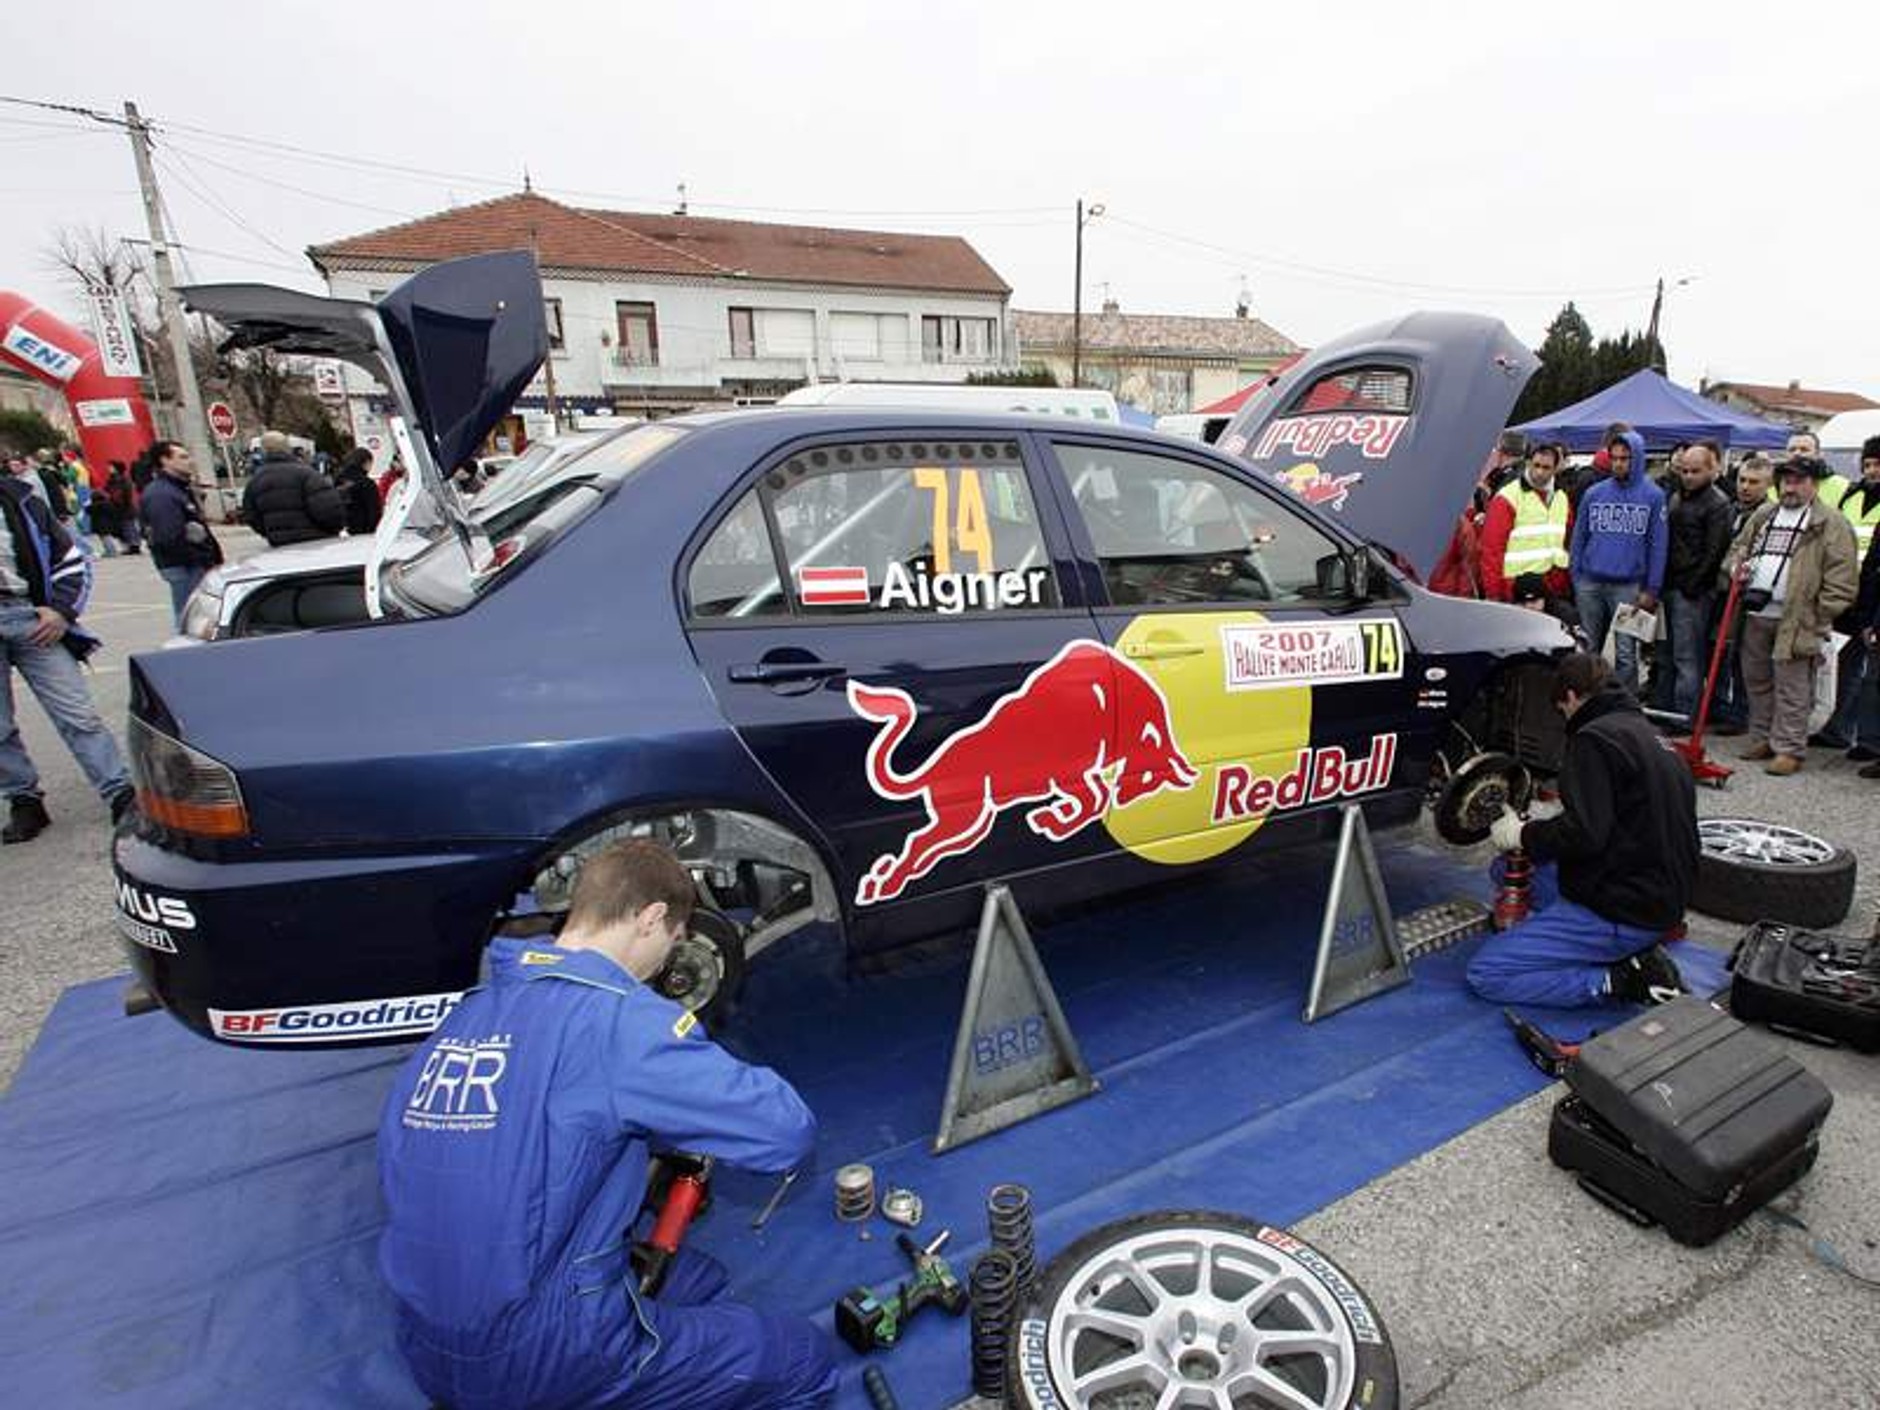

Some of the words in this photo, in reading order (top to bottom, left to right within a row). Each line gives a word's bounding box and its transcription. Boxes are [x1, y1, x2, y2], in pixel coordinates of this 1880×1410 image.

[913, 467, 994, 574] 74
[1589, 503, 1651, 535] PORTO
[880, 560, 1047, 614] Aigner
[1234, 640, 1276, 678] RALLYE
[1279, 655, 1318, 675] MONTE
[1320, 636, 1358, 672] CARLO
[1259, 631, 1332, 652] 2007
[1361, 623, 1399, 675] 74
[222, 998, 456, 1032] BFGoodrich
[975, 1015, 1042, 1068] BRR
